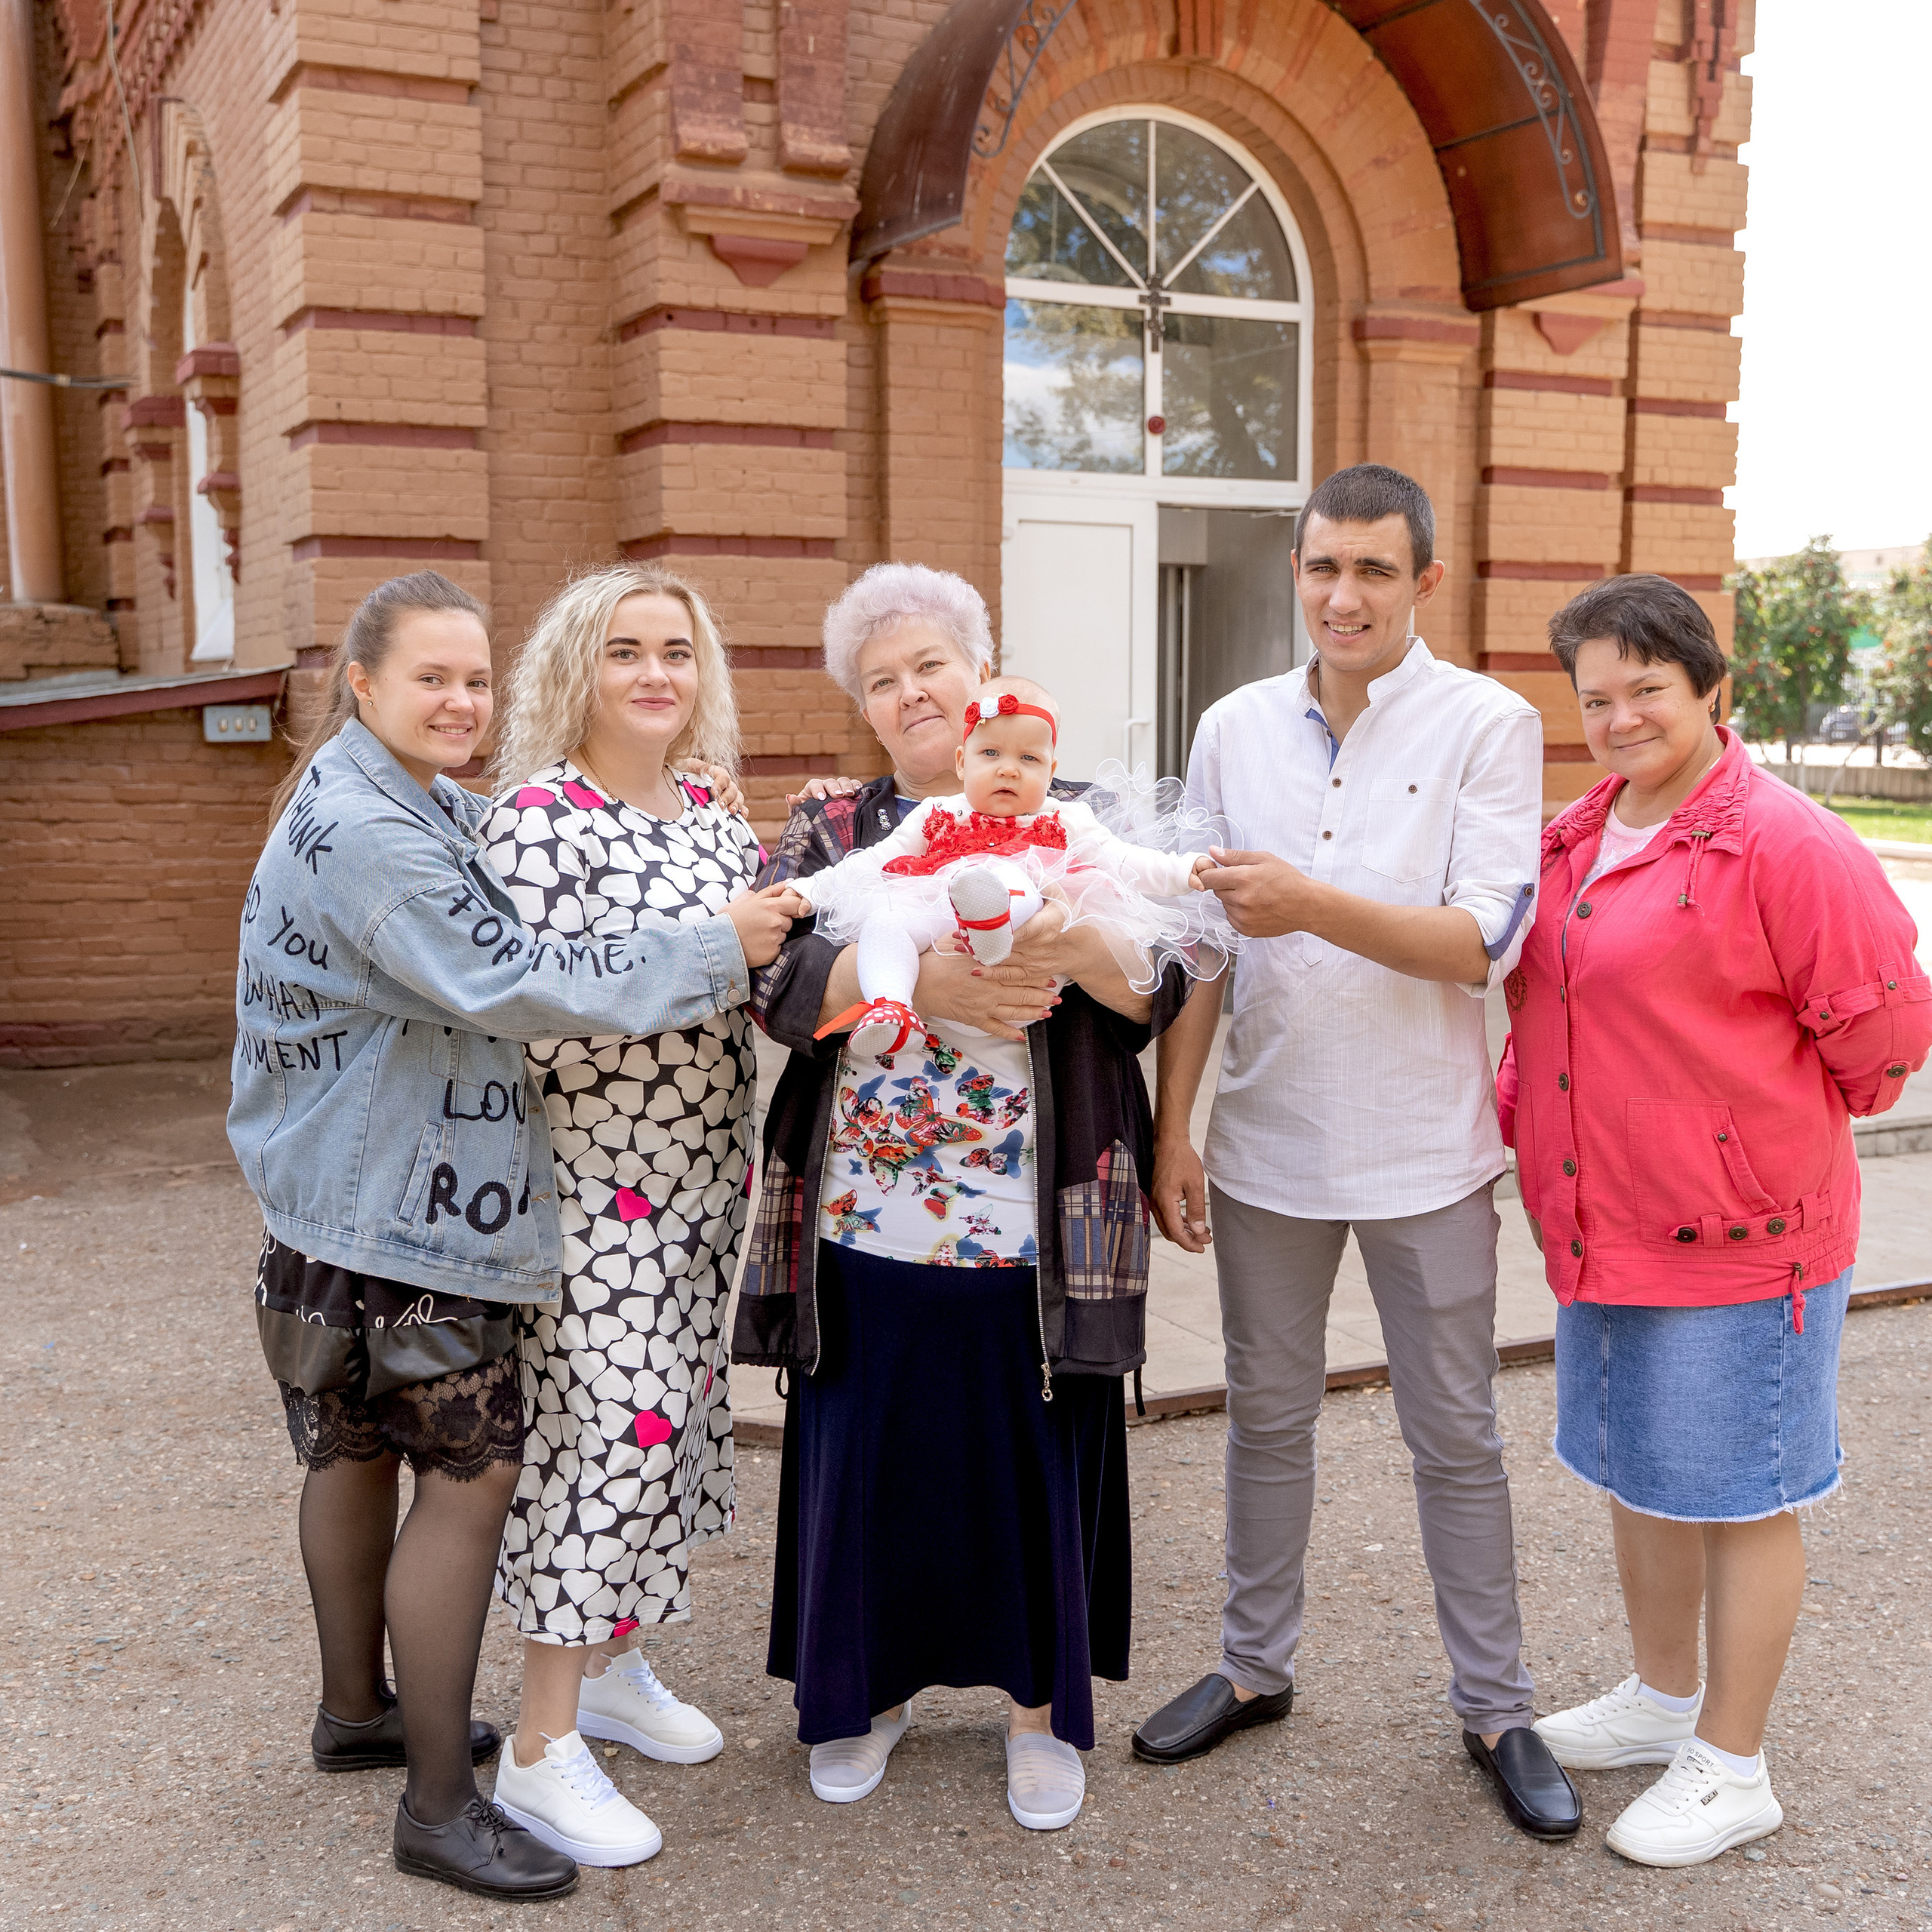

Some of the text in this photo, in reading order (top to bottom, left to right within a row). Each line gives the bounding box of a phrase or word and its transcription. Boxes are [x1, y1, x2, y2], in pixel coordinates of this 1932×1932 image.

[244, 957, 320, 1022] WHAT
[237, 1026, 348, 1074] NMENT
[1694, 1751, 1715, 1767] SPORT
